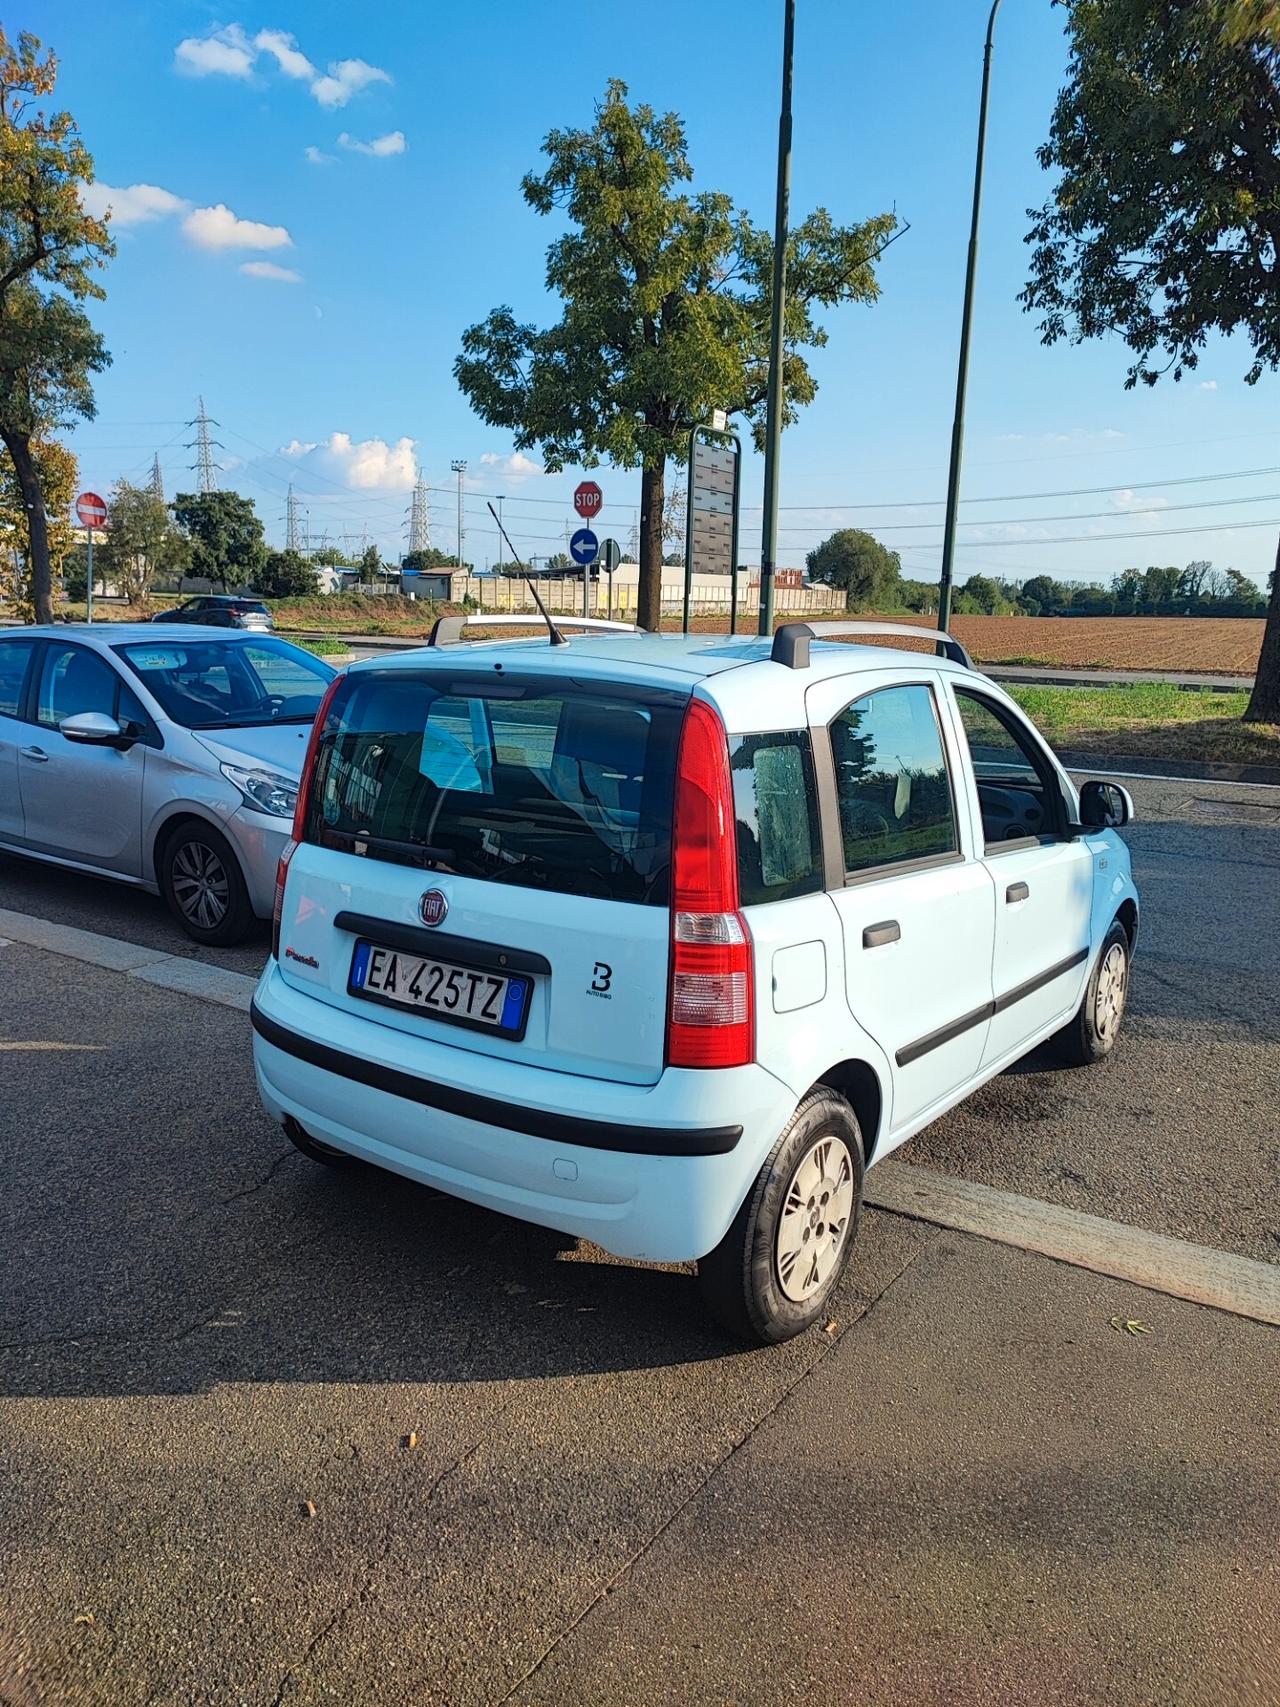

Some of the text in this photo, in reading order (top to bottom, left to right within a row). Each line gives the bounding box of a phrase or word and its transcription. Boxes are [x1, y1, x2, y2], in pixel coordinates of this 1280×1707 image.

[575, 493, 600, 507] STOP
[423, 899, 441, 918] FIAT
[367, 950, 504, 1020] EA 425TZ
